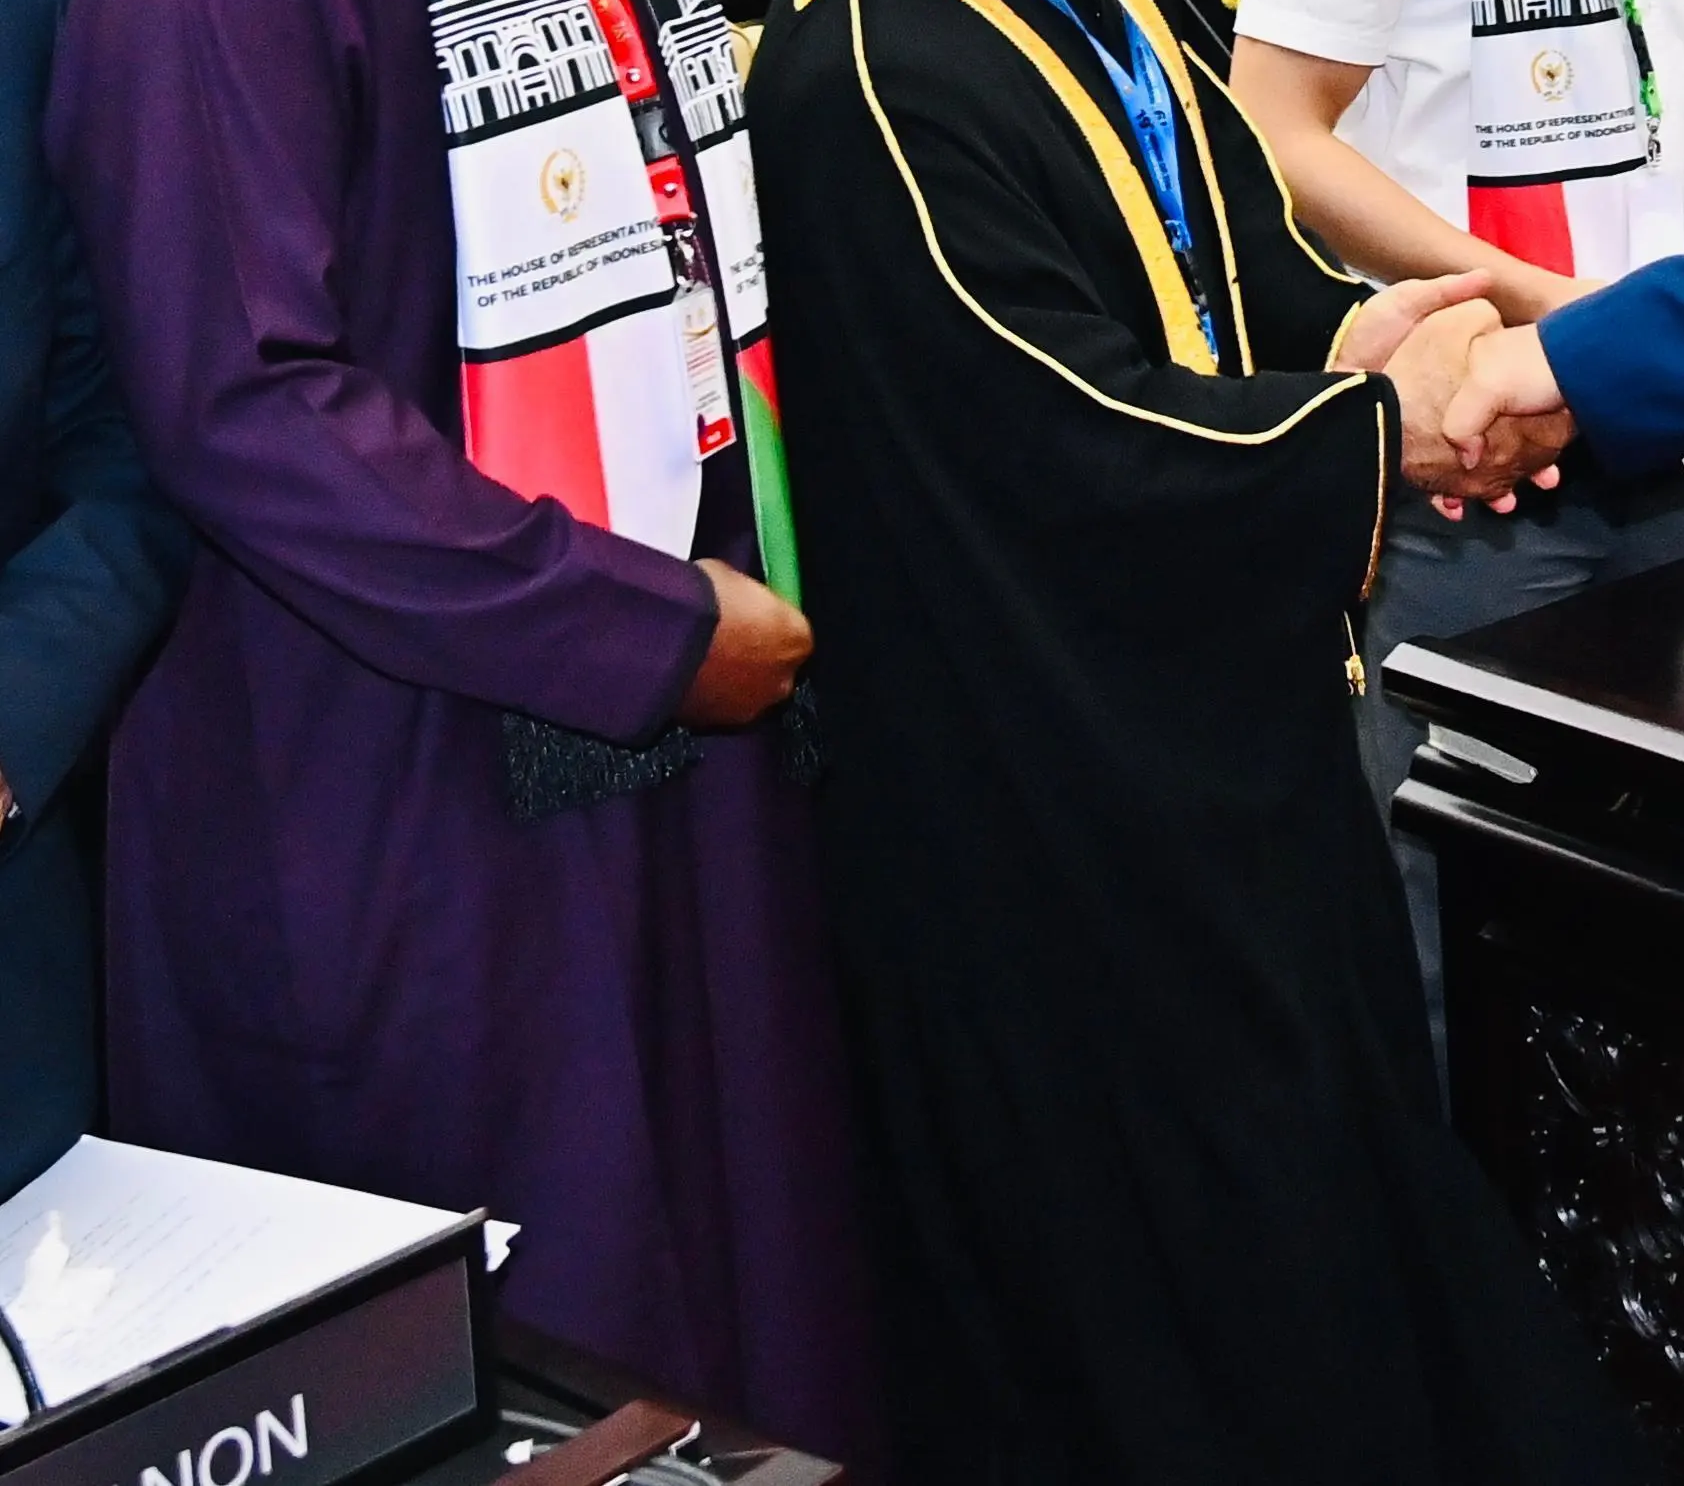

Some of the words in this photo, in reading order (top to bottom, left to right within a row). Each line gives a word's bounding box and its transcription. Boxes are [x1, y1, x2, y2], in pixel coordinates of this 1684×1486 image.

[1474, 124, 1493, 134] THE
[1496, 121, 1532, 133] HOUSE
[1535, 119, 1547, 130] OF
[1549, 106, 1635, 127] REPRESENTATIVE
[1480, 139, 1492, 149] OF
[1495, 138, 1516, 149] THE
[1519, 132, 1565, 146] REPUBLIC
[1567, 130, 1581, 140] OF
[467, 271, 498, 288] THE
[501, 256, 547, 280] HOUSE
[549, 249, 565, 265] OF
[567, 216, 660, 259] REPRESENTATIV
[477, 293, 498, 308] OF
[501, 284, 529, 302] THE
[532, 263, 586, 293] REPUBLIC
[586, 255, 601, 271] OF
